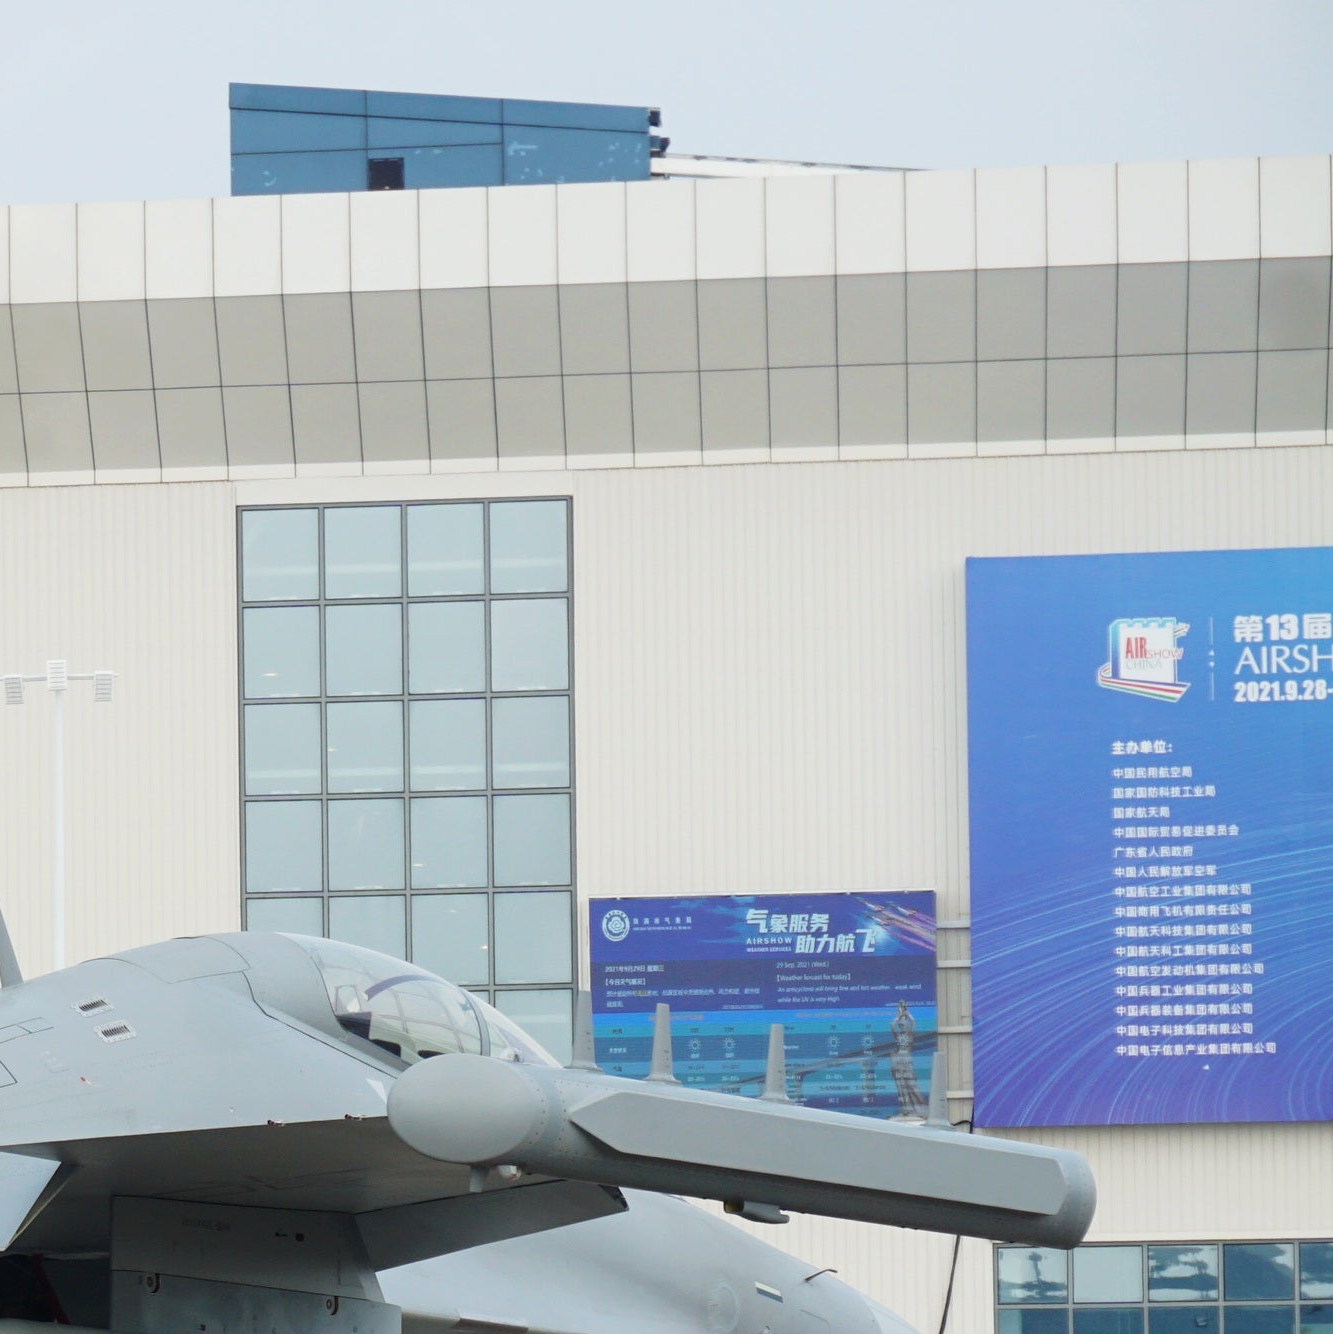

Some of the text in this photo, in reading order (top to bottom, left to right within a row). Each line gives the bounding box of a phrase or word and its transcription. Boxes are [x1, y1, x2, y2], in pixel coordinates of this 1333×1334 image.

[1234, 612, 1333, 643] 第13届
[1112, 766, 1193, 779] 中国民用航空局
[1112, 806, 1171, 819] 国家航天局
[1113, 846, 1194, 858] 广东省人民政府
[1114, 884, 1252, 898] 中国航空工业集团有限公司
[745, 908, 830, 934] 气象服务
[1115, 923, 1253, 938] 中国航天科技集团有限公司
[746, 937, 792, 945] AIRSHOW
[795, 928, 878, 954] 助力航飞
[1115, 943, 1253, 957] 中国航天科工集团有限公司
[1116, 1022, 1254, 1037] 中国电子科技集团有限公司
